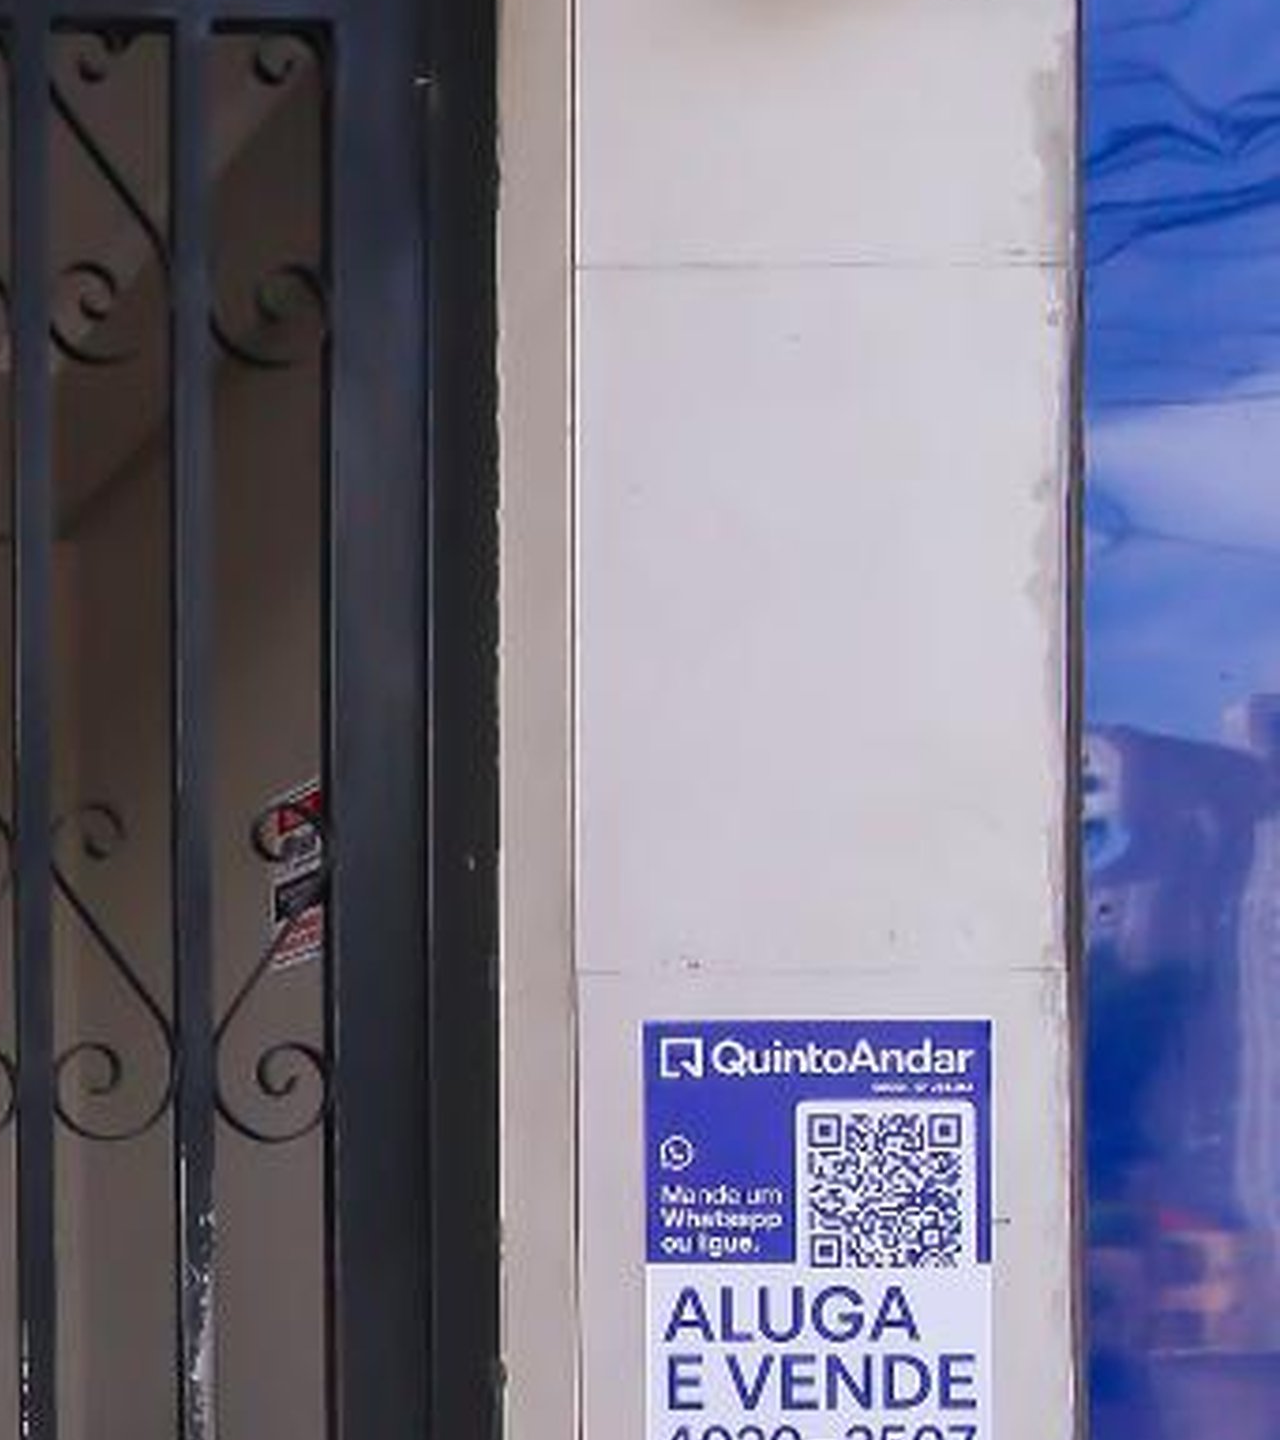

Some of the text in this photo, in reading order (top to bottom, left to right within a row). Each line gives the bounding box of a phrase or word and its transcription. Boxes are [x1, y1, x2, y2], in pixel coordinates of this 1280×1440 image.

[712, 1038, 975, 1076] QuintoAndar
[660, 1185, 783, 1205] Mande um
[660, 1237, 692, 1254] ou
[663, 1285, 921, 1344] ALUGA
[667, 1354, 978, 1411] E VENDE
